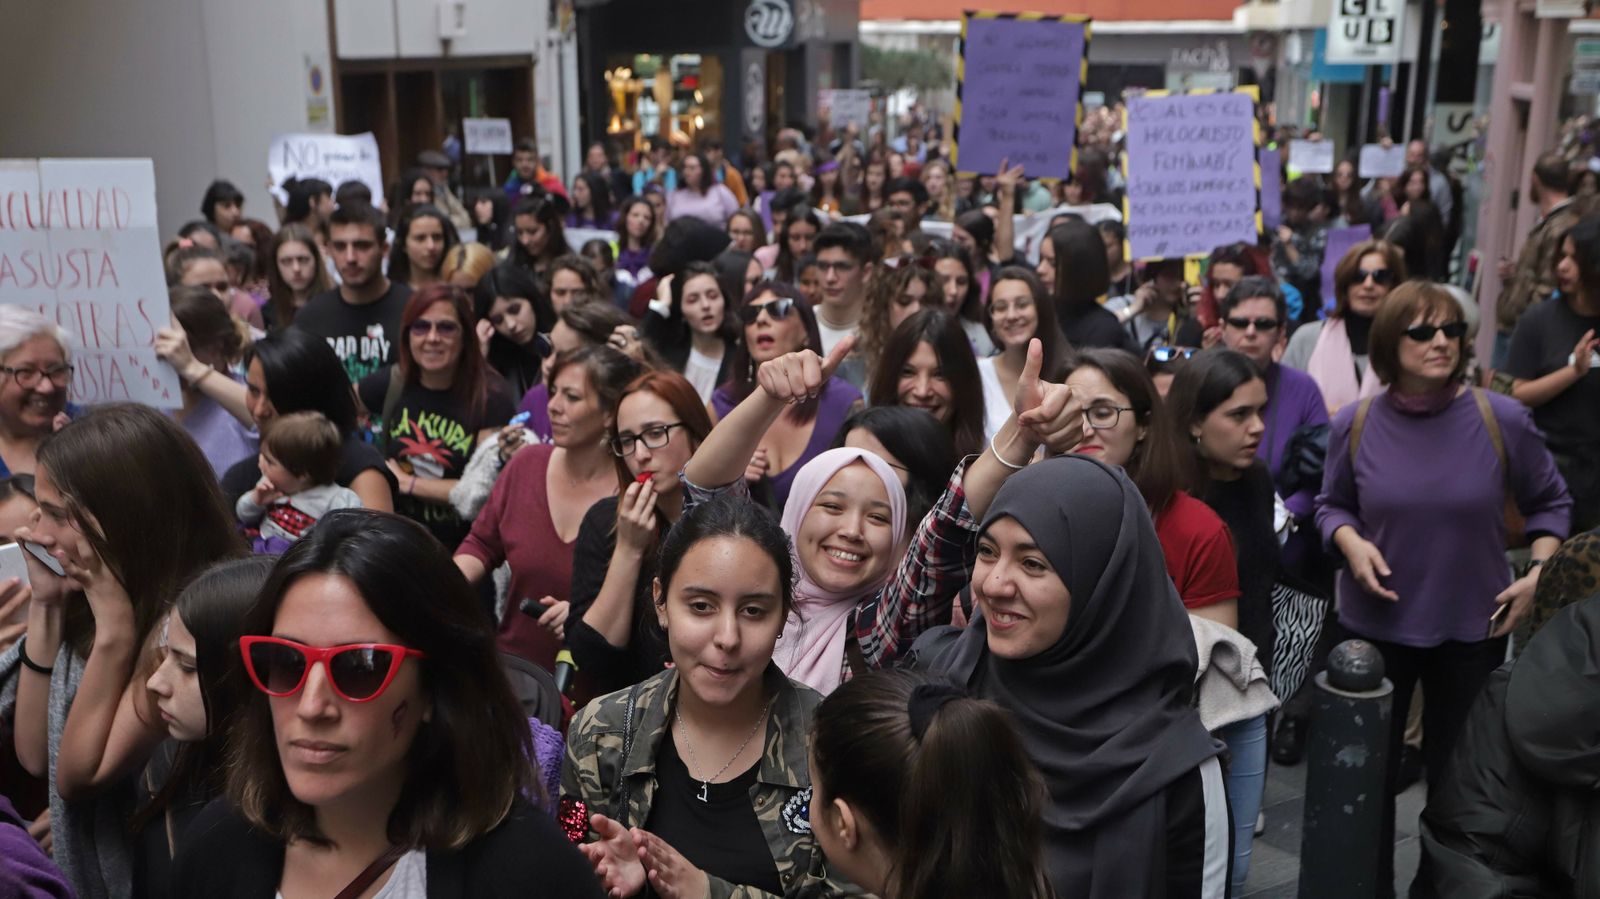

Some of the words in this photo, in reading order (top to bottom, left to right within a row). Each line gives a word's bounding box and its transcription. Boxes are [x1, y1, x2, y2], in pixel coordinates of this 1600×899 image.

[1144, 125, 1246, 145] HOLOCAUSTO
[283, 139, 319, 169] NO
[0, 249, 120, 289] ASUSTA
[361, 335, 391, 362] DAY
